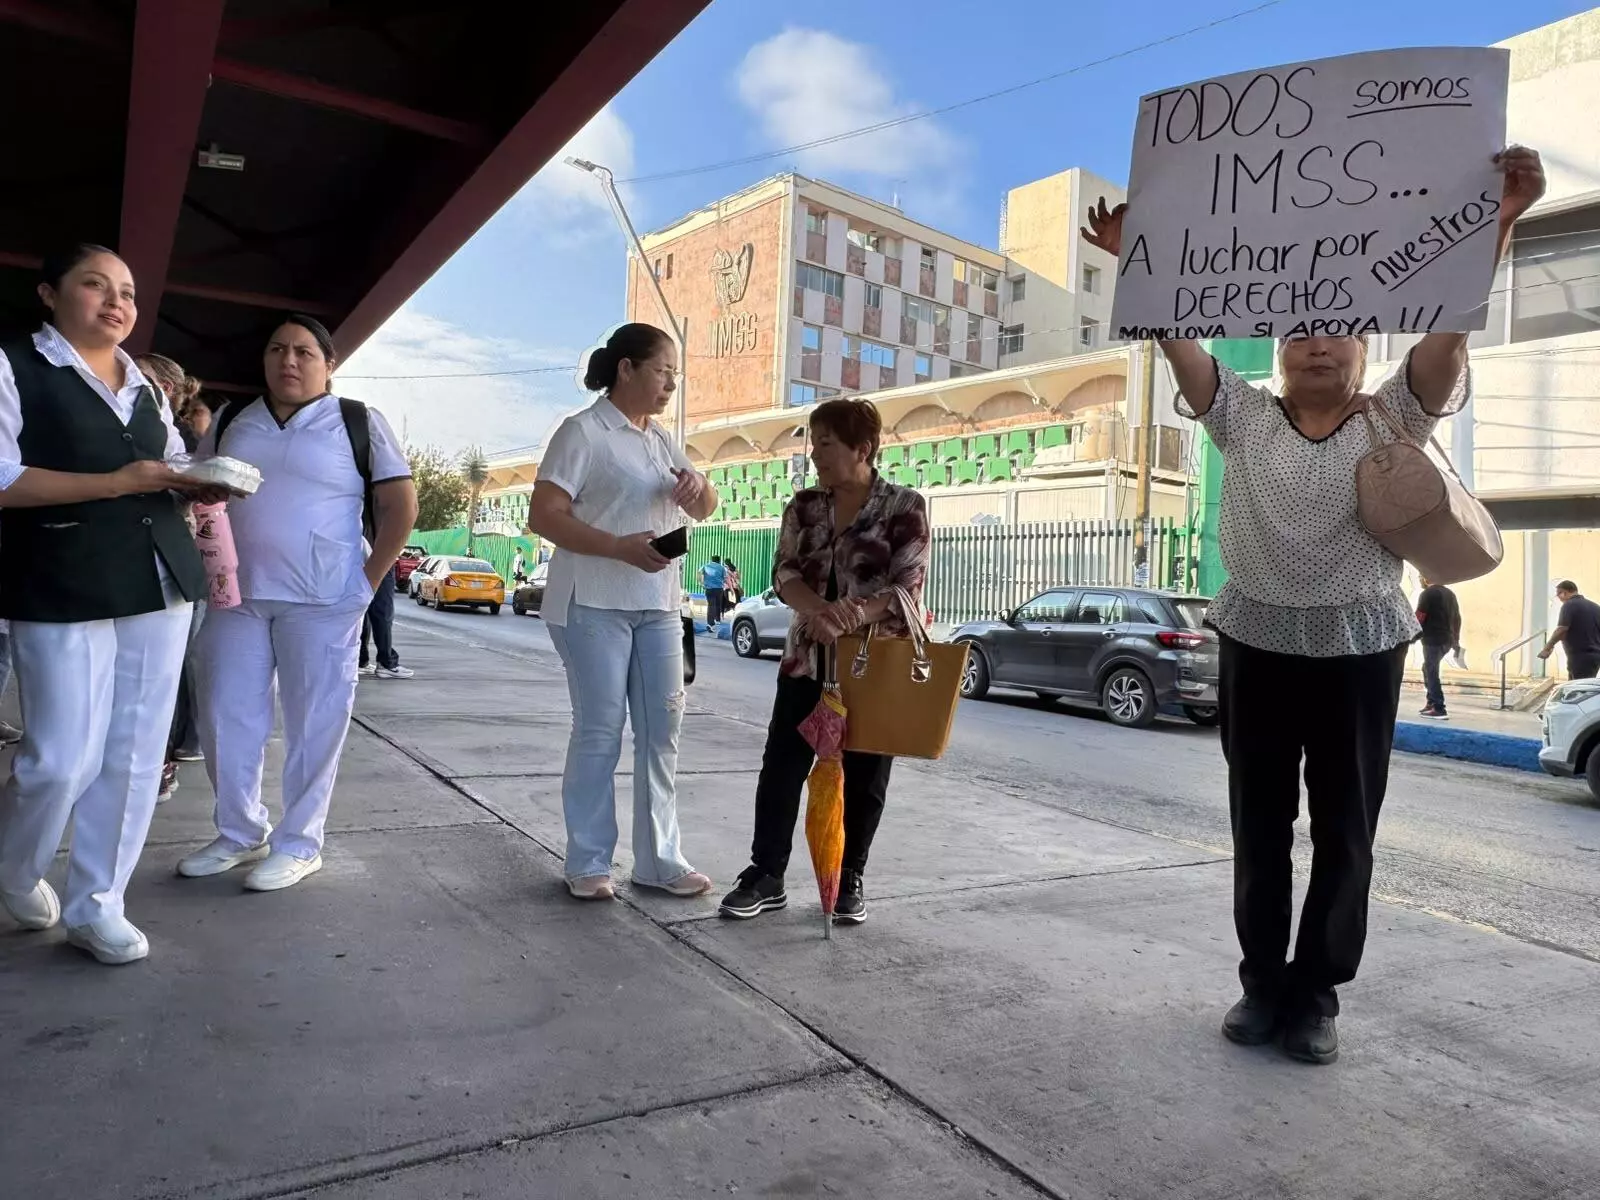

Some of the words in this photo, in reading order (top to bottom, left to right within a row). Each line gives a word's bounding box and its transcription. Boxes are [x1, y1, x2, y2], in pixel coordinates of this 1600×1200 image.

[1145, 67, 1316, 147] TODOS
[1353, 76, 1471, 108] somos
[1121, 234, 1152, 276] A
[1180, 226, 1300, 276] luchar
[1309, 229, 1379, 280] por
[1370, 190, 1500, 286] nuestros
[1174, 277, 1354, 322] DERECHOS
[708, 312, 758, 359] IMSS
[1119, 324, 1227, 341] MONCLOVA
[1254, 322, 1274, 338] SI
[1288, 318, 1380, 338] APOYA
